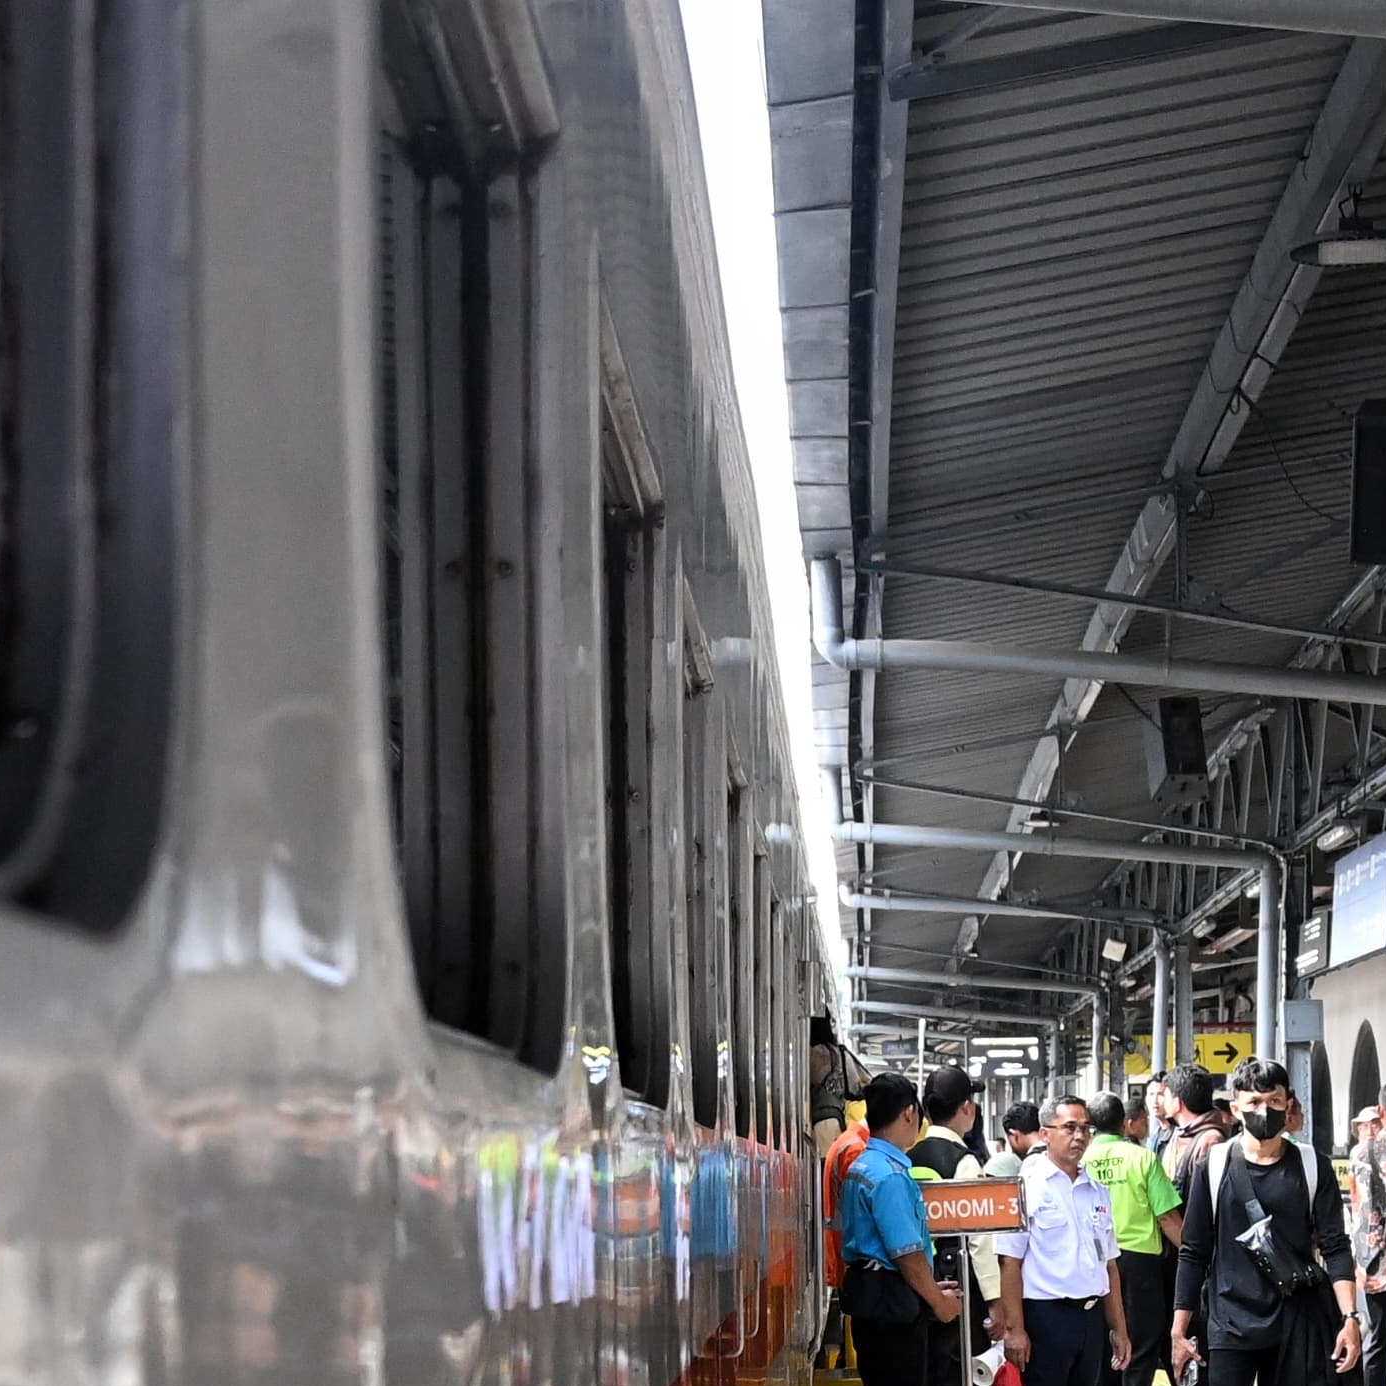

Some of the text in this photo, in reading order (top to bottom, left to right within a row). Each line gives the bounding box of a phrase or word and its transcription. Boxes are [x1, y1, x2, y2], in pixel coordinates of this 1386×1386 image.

[1098, 1169, 1113, 1180] 110
[924, 1198, 994, 1219] ONOMI
[1008, 1197, 1019, 1215] 3
